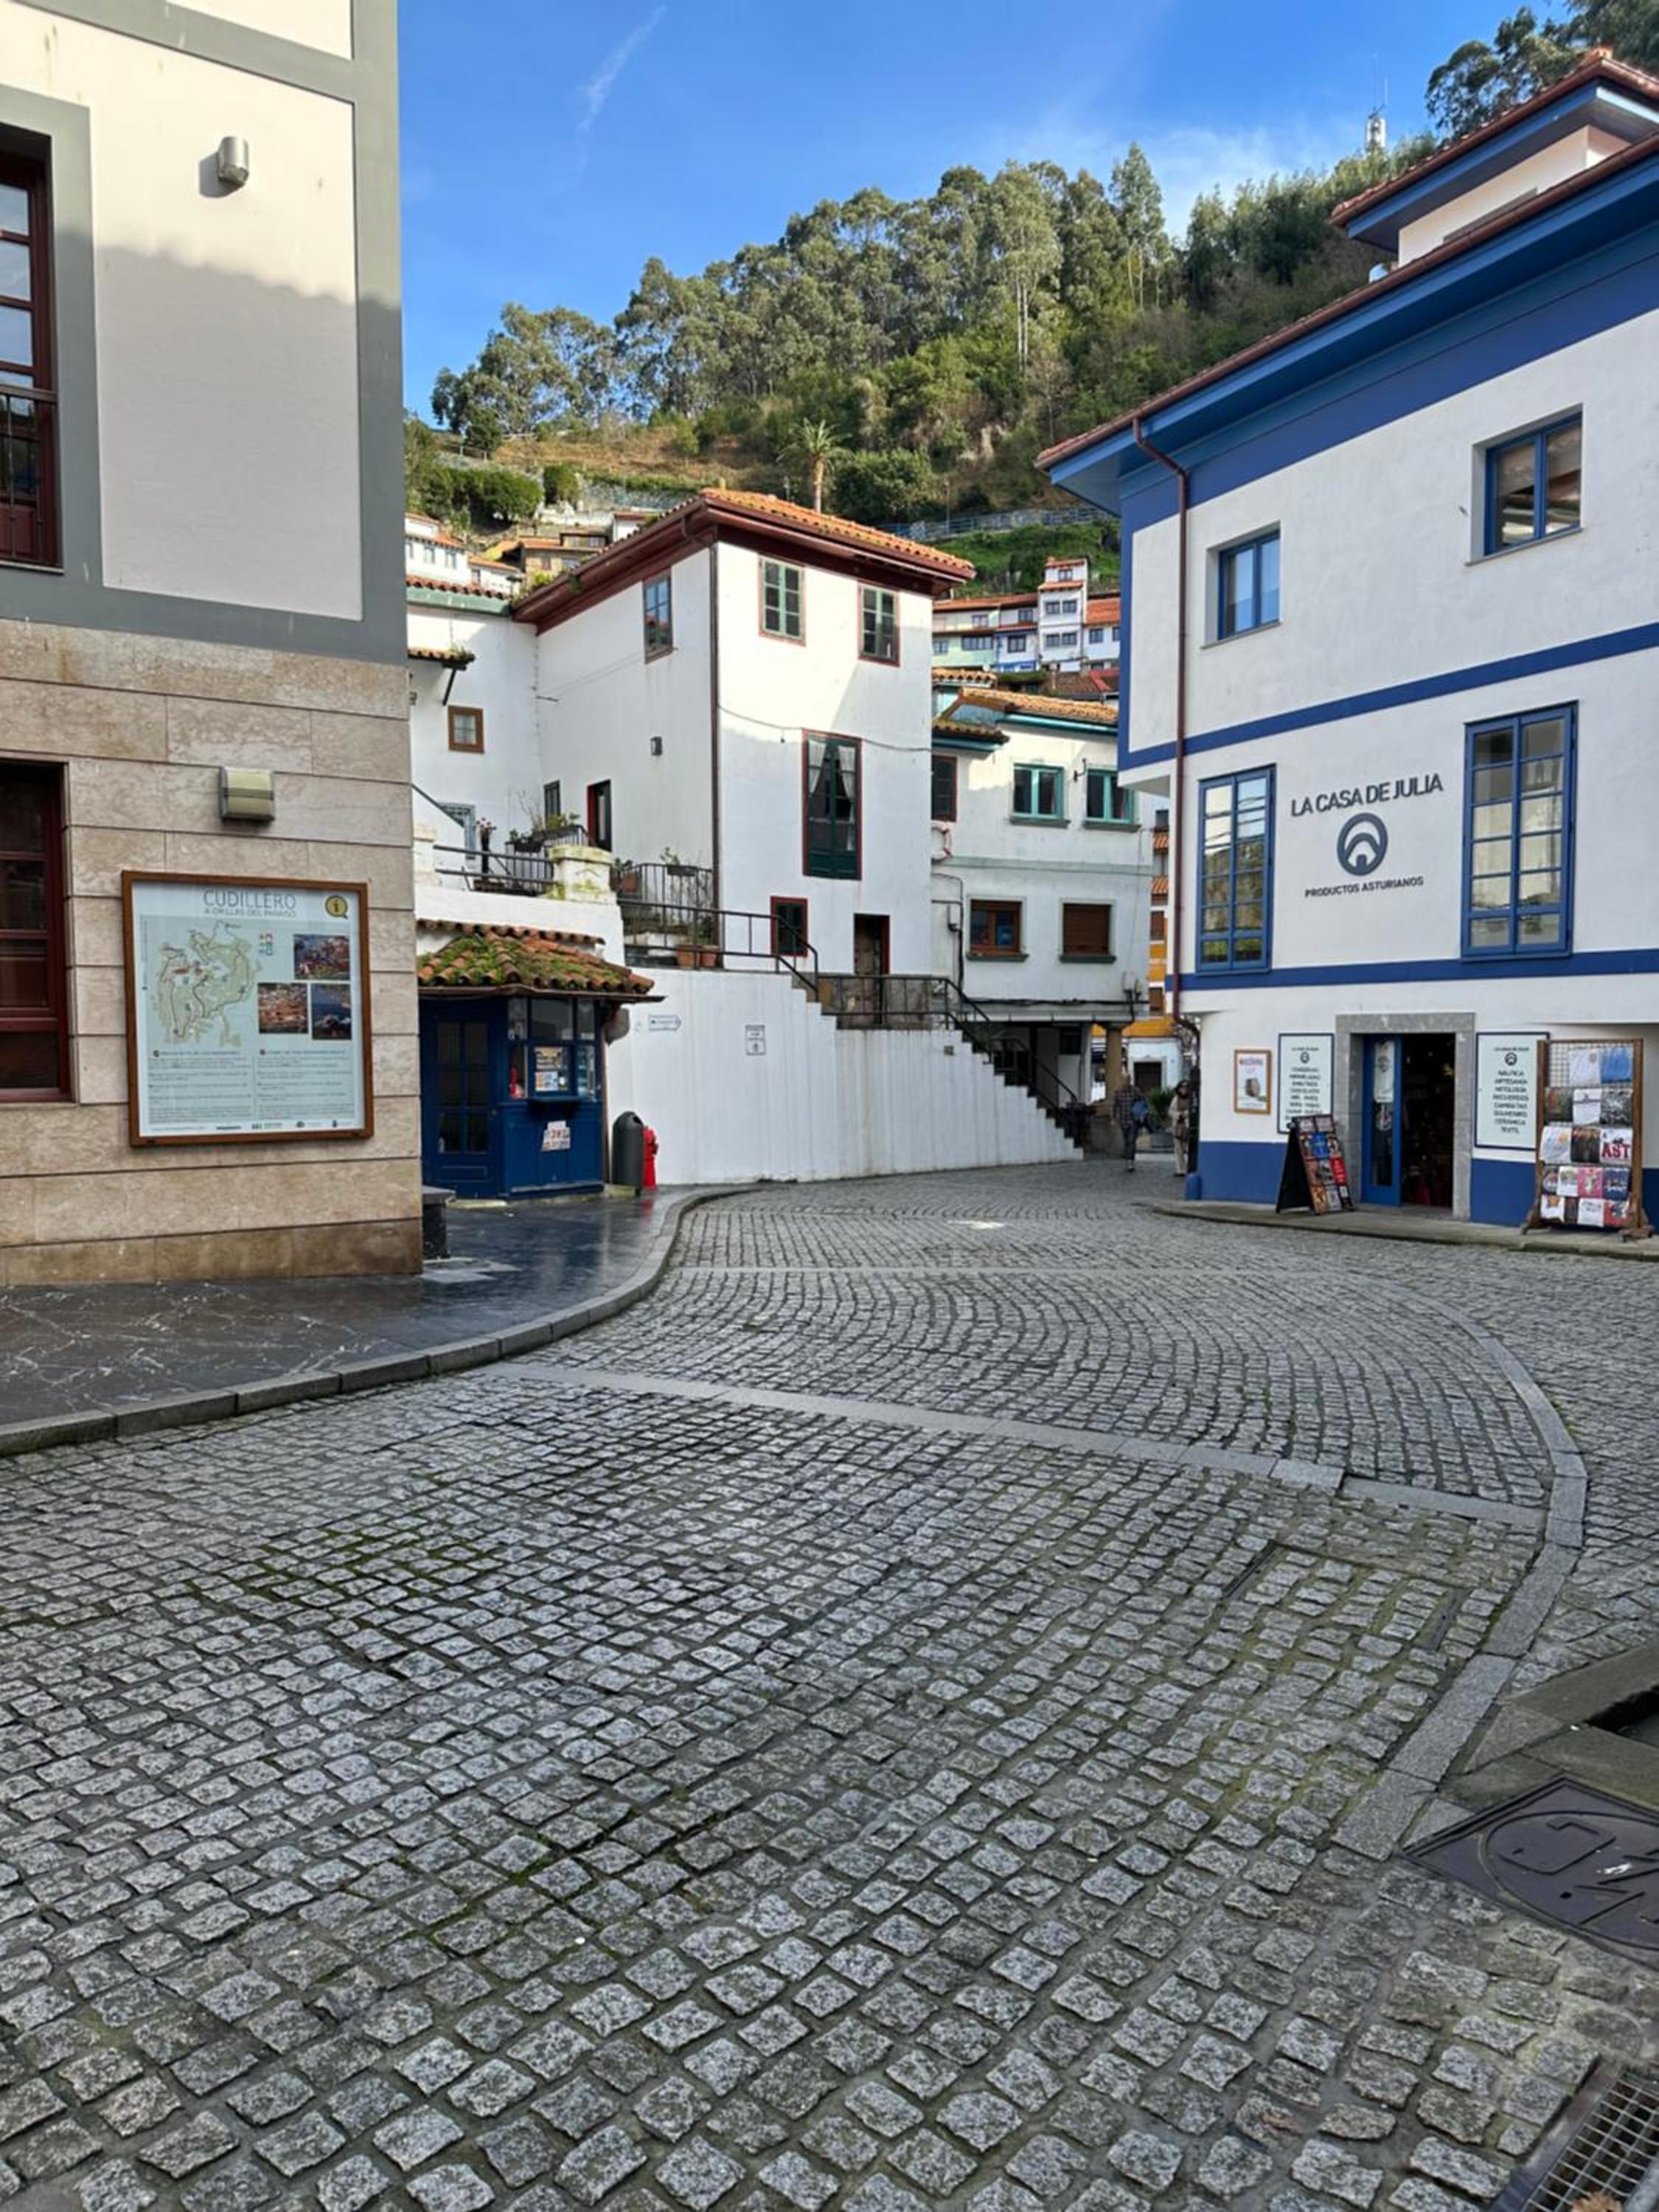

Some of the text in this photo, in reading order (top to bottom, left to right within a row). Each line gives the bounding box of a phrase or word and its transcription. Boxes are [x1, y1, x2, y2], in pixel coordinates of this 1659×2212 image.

[1291, 772, 1444, 817] LA CASA DE JULIA
[1304, 875, 1424, 898] PRODUCTOS ASTURIANOS
[203, 888, 296, 910] CUDILLERO
[1602, 1142, 1630, 1158] AST
